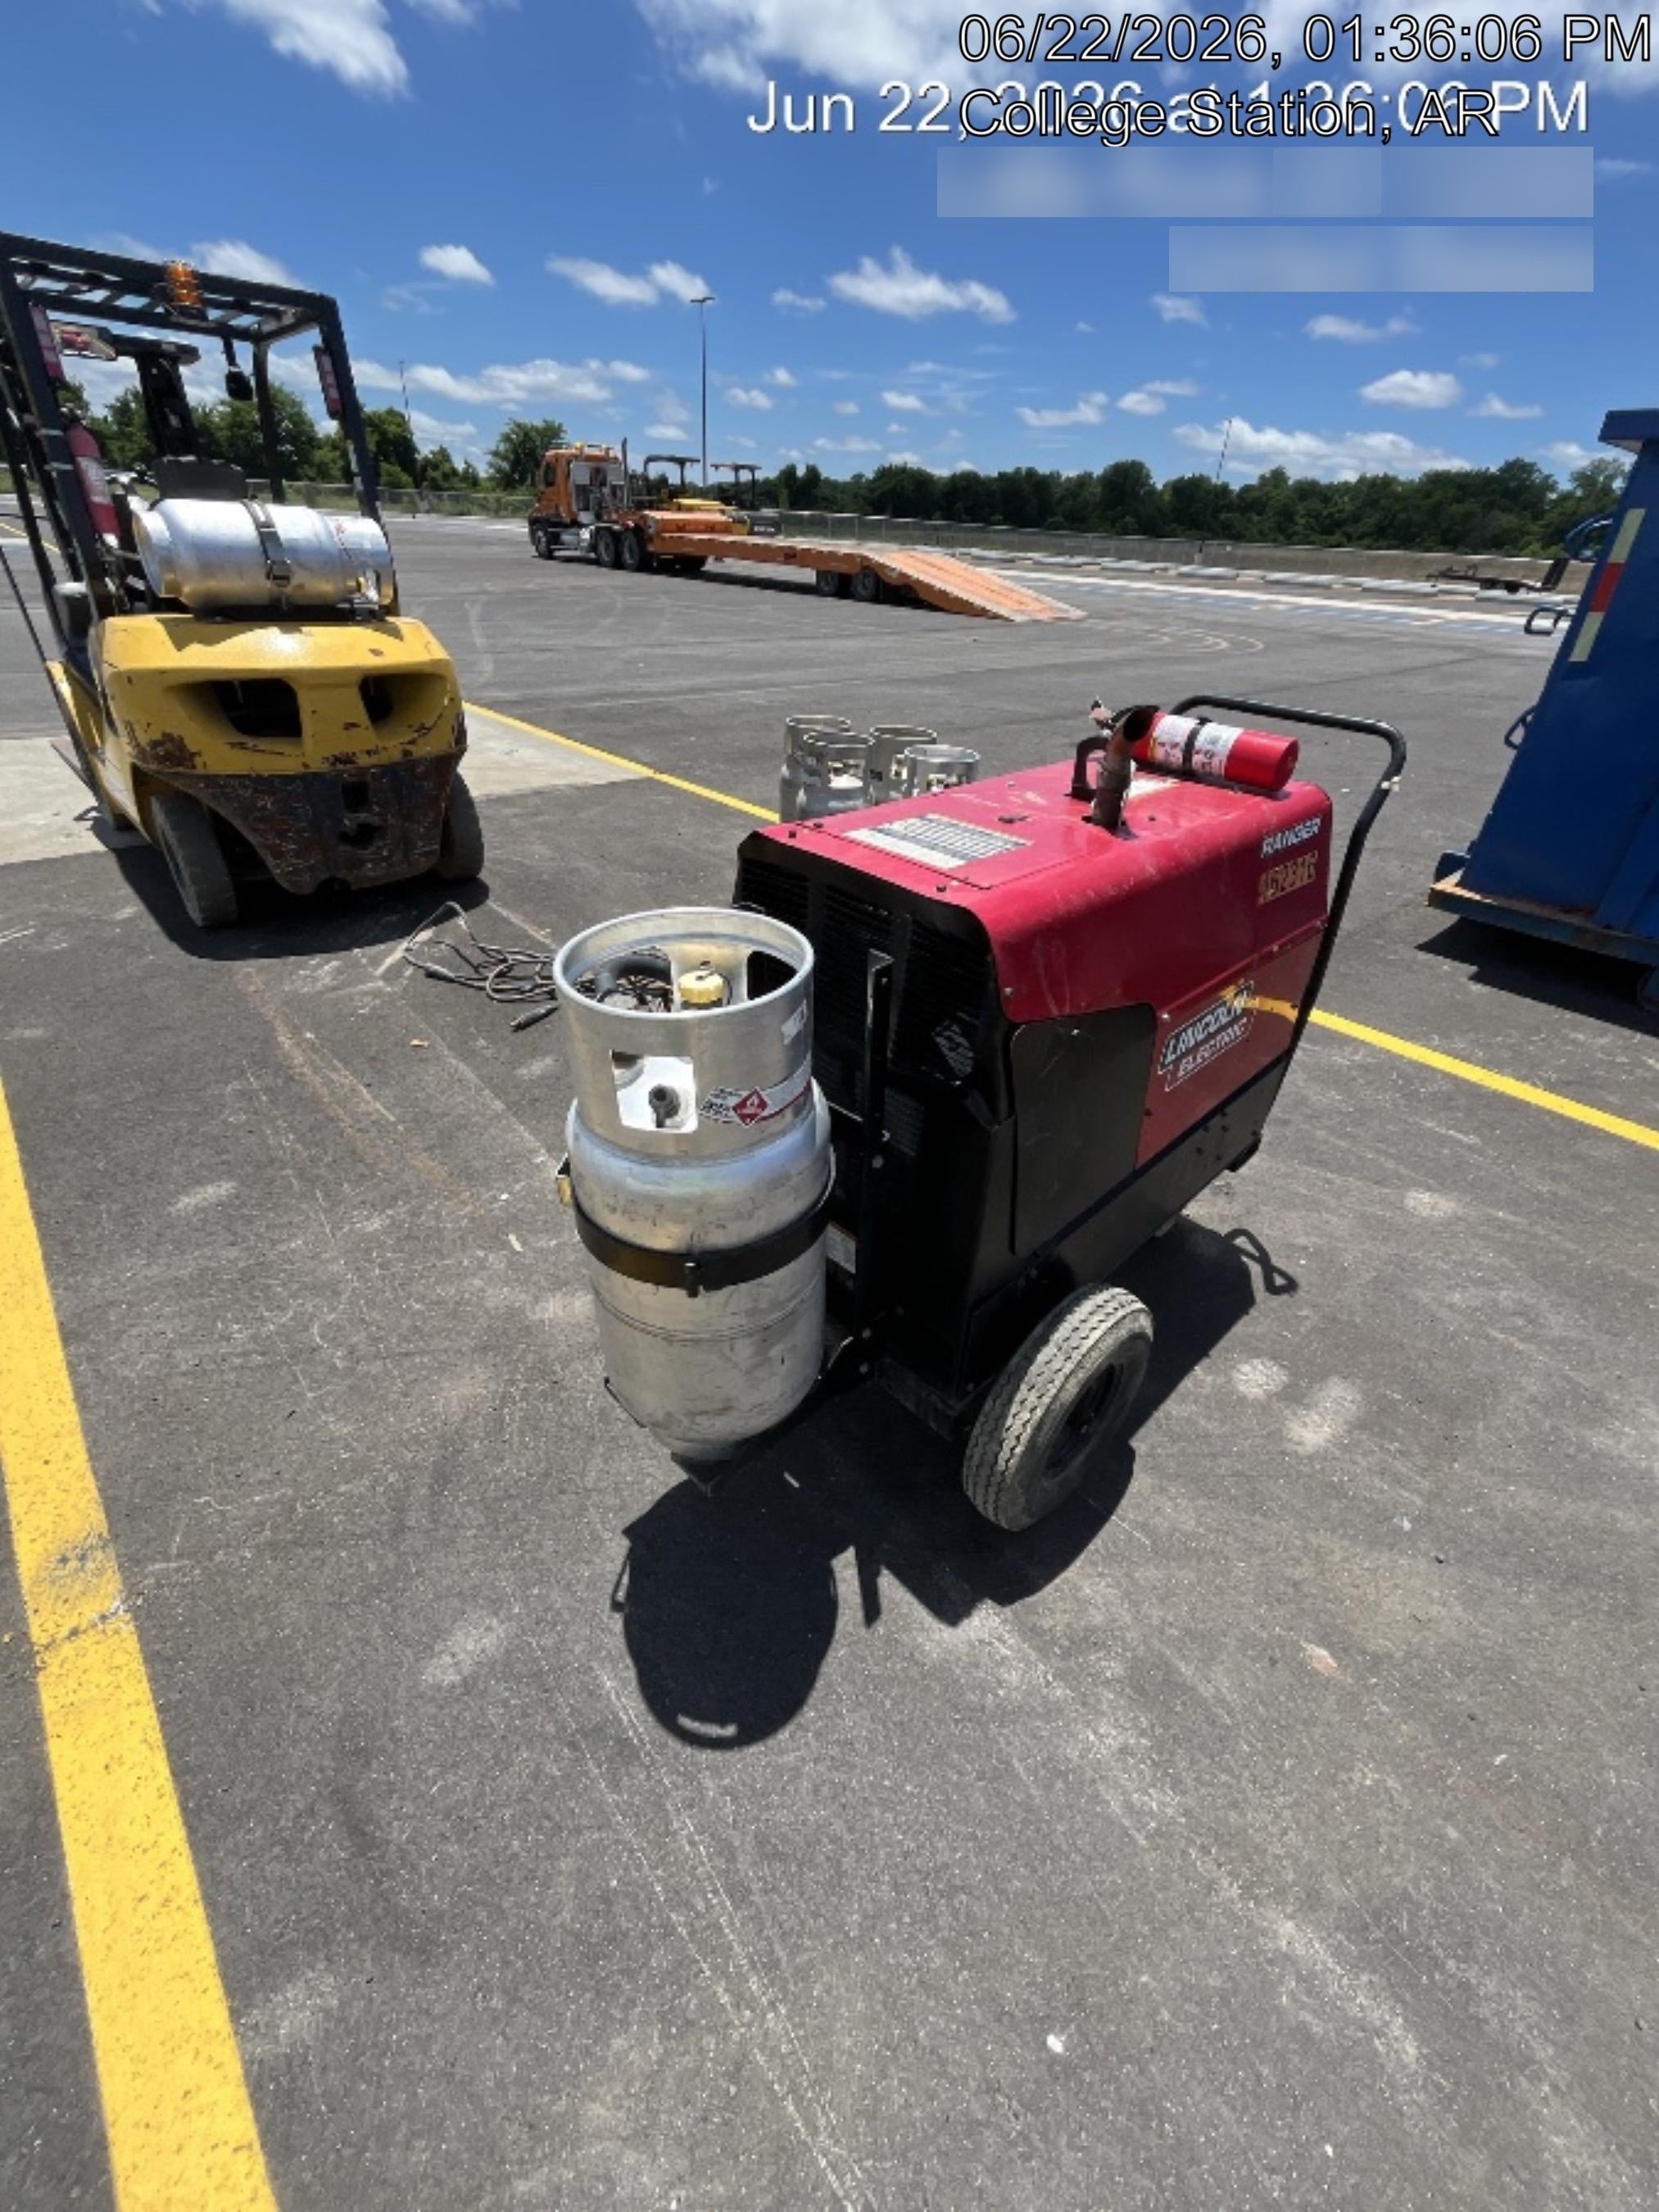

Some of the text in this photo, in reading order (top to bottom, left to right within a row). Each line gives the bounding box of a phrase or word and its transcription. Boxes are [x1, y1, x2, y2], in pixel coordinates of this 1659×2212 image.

[1260, 816, 1322, 859] RANGER
[1163, 988, 1249, 1065] LINCOLN
[1176, 1017, 1248, 1078] ELECTRIC
